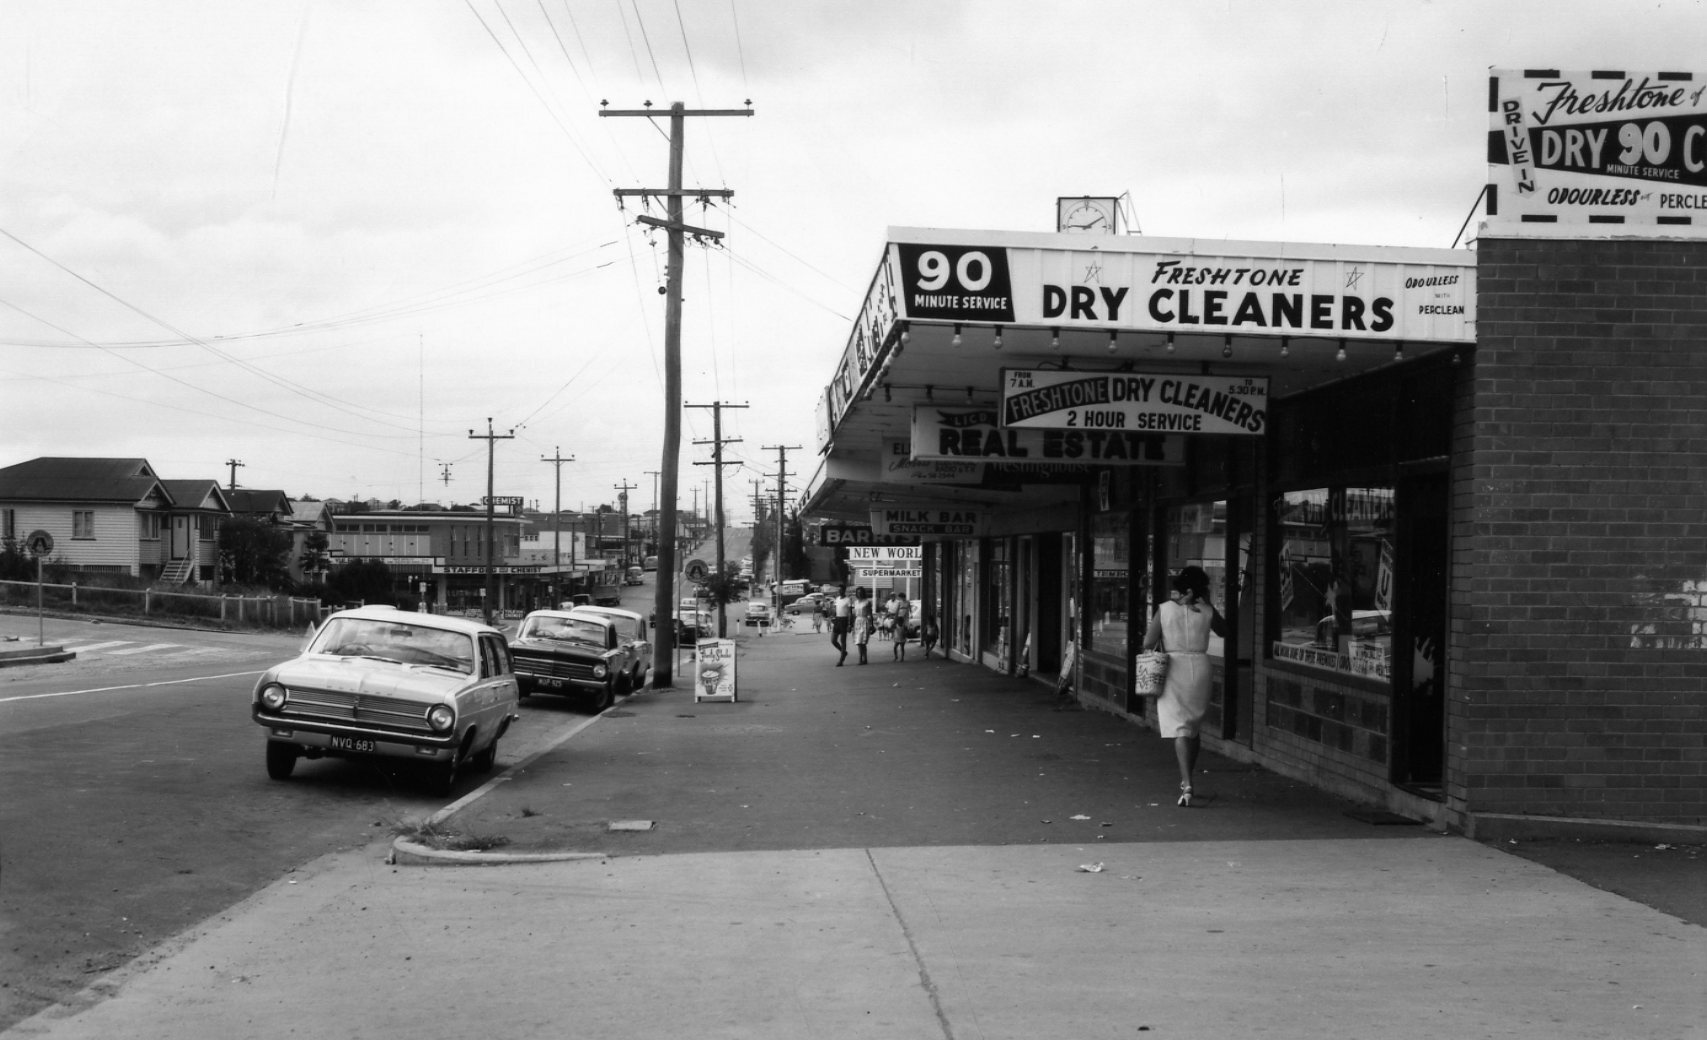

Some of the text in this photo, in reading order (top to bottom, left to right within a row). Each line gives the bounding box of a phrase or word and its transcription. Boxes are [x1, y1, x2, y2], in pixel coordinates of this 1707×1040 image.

[1532, 77, 1684, 125] Freshtone
[1541, 128, 1608, 168] DRY
[1618, 120, 1671, 165] 90
[1606, 163, 1680, 179] MINUTE SERVICE
[1548, 187, 1641, 205] ODOURLESS
[917, 250, 992, 291] 90
[1151, 260, 1304, 287] FRESHTONE
[915, 294, 1007, 310] MINUTE SERVICE
[1042, 284, 1394, 333] DRY CLEANERS
[1419, 304, 1465, 316] PERCLEAN
[1010, 379, 1017, 388] 7
[1014, 371, 1032, 379] FROM
[1009, 376, 1266, 433] FRESHTONE DRY CLEANERS
[1067, 410, 1202, 432] 2 HOUR SERVICE
[940, 429, 1166, 461] REAL ESTATE
[886, 510, 977, 524] MILK BAR
[891, 524, 971, 534] SNACK BAR
[854, 548, 921, 558] NEW WORL
